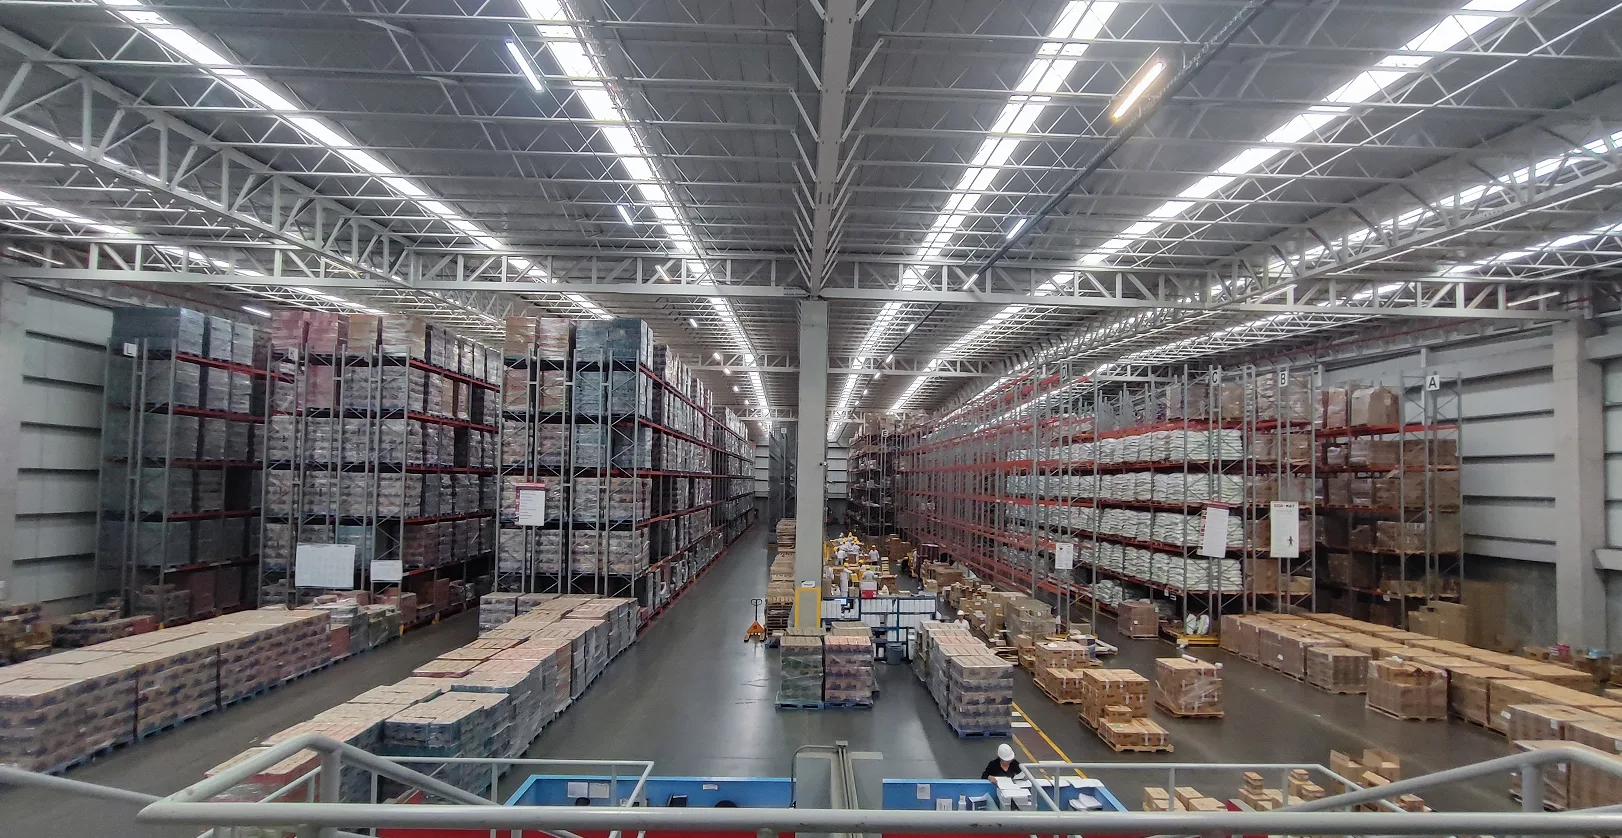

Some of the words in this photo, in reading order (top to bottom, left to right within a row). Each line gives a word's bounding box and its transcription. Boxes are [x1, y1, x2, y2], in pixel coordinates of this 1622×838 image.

[126, 343, 133, 355] L
[1212, 371, 1218, 384] C
[1280, 373, 1286, 385] B
[1428, 376, 1437, 389] A
